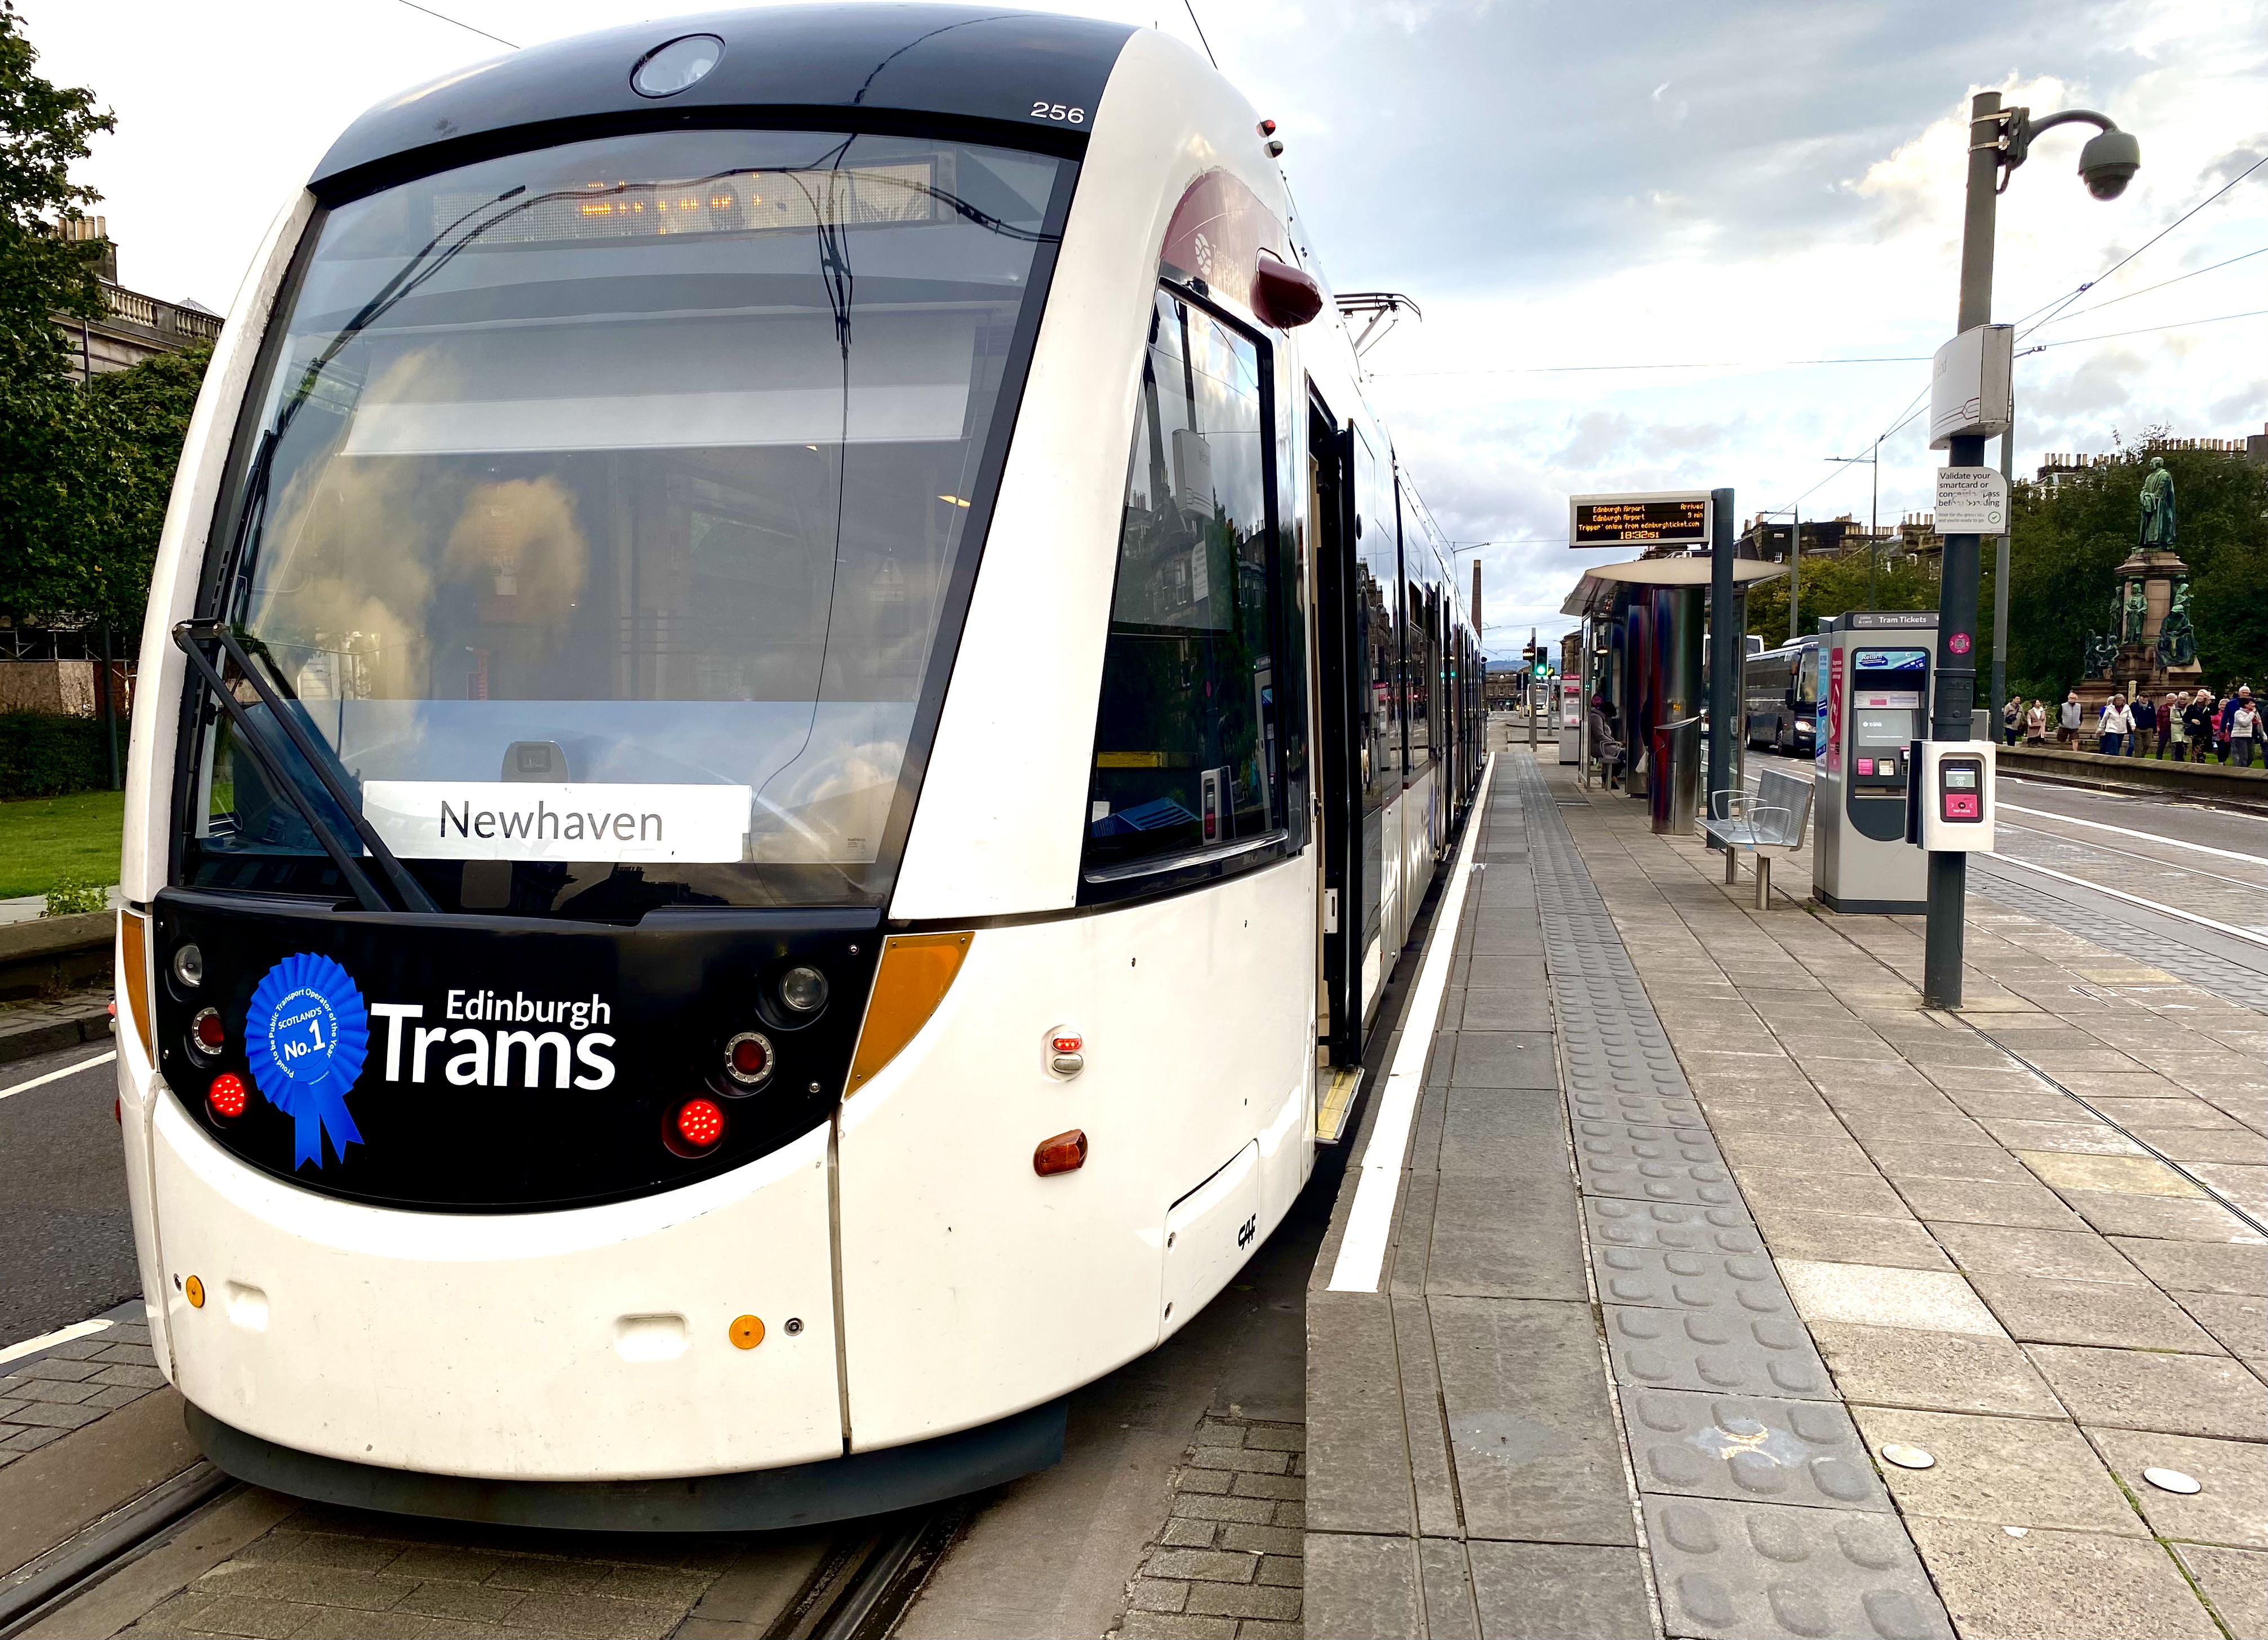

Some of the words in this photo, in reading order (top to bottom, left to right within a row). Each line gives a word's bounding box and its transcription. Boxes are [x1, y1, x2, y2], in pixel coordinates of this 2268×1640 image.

[1030, 101, 1085, 123] 256
[1620, 531, 1659, 539] 18:32:51
[1641, 521, 1699, 529] edinburghticket.com
[440, 800, 662, 841] Newhaven
[276, 989, 304, 1011] Transport
[305, 988, 331, 1012] Operator
[446, 989, 611, 1030] Edinburgh
[269, 1012, 279, 1038] Public
[278, 1007, 322, 1029] SCOTLAND'S
[329, 1012, 336, 1021] of
[270, 1040, 276, 1051] be
[273, 1051, 279, 1060] to
[327, 1039, 337, 1059] Year
[371, 1003, 616, 1090] Trams
[276, 1060, 294, 1078] Proud
[1238, 1212, 1256, 1251] CAF
